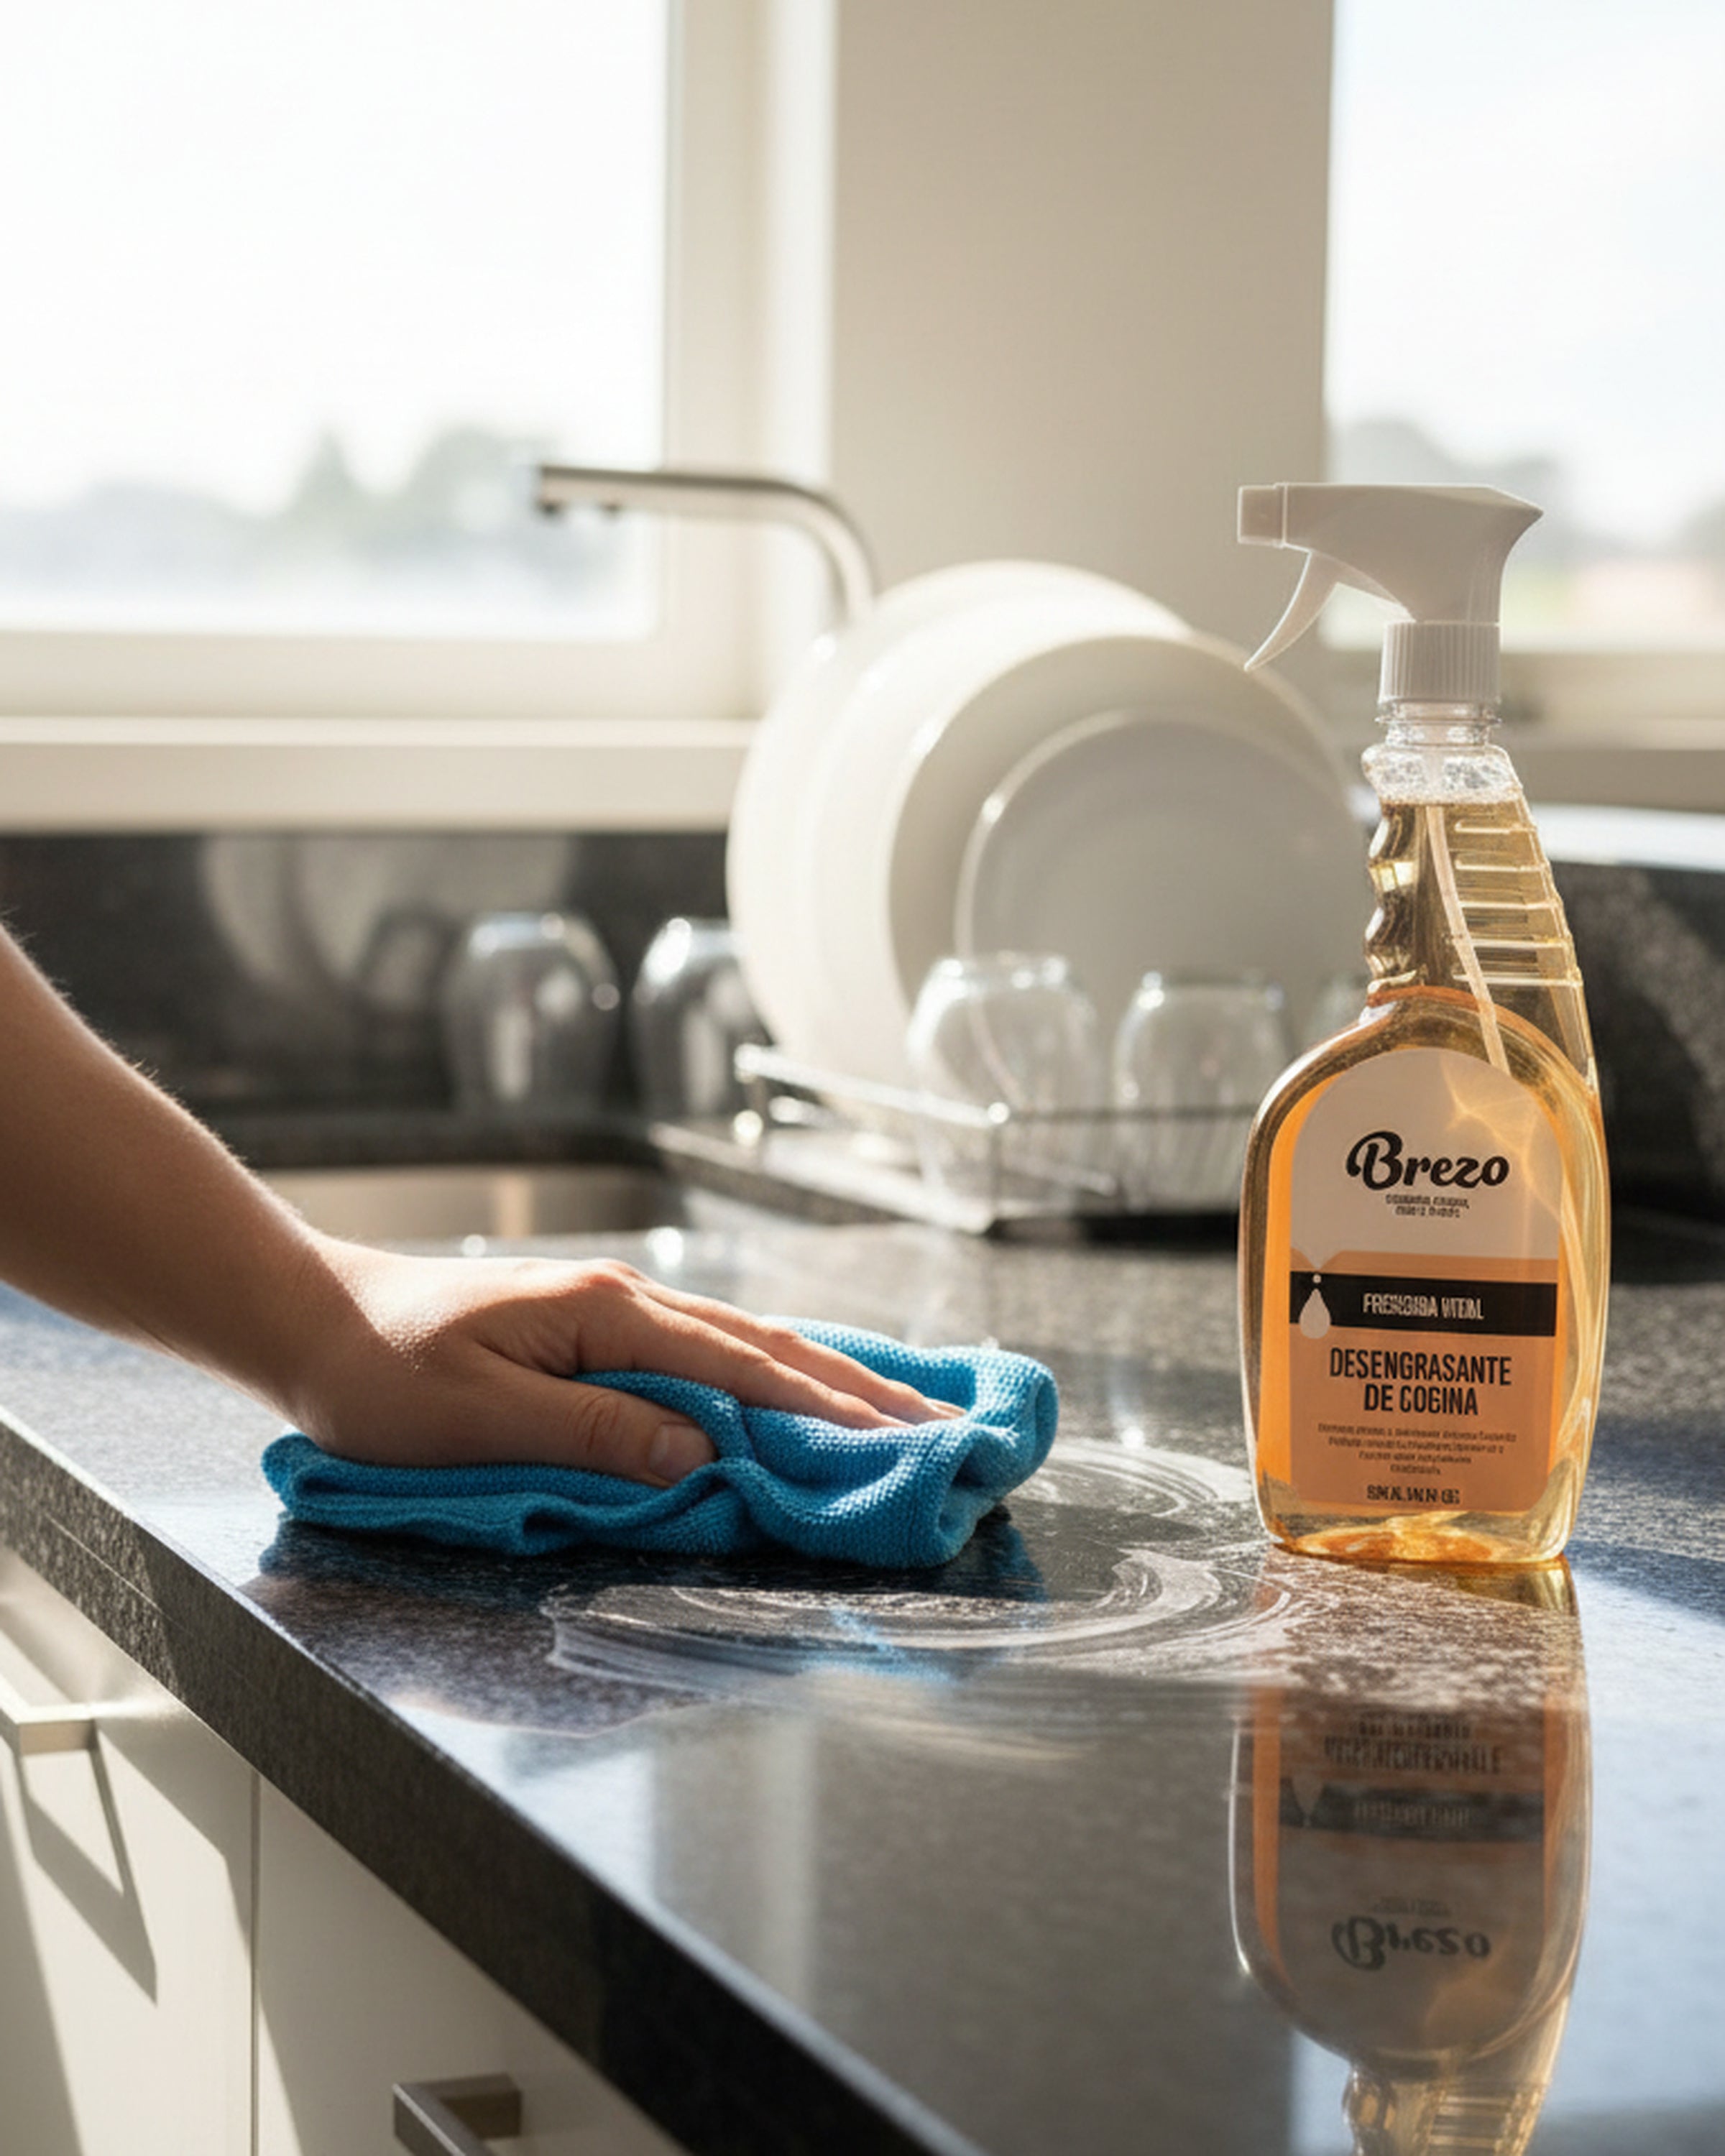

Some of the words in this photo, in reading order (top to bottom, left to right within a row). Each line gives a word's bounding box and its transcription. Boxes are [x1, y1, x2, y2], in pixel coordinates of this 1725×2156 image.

[1346, 1130, 1509, 1191] Brezo
[1329, 1346, 1512, 1386] DESENGRASANTE
[1363, 1383, 1394, 1412] DE
